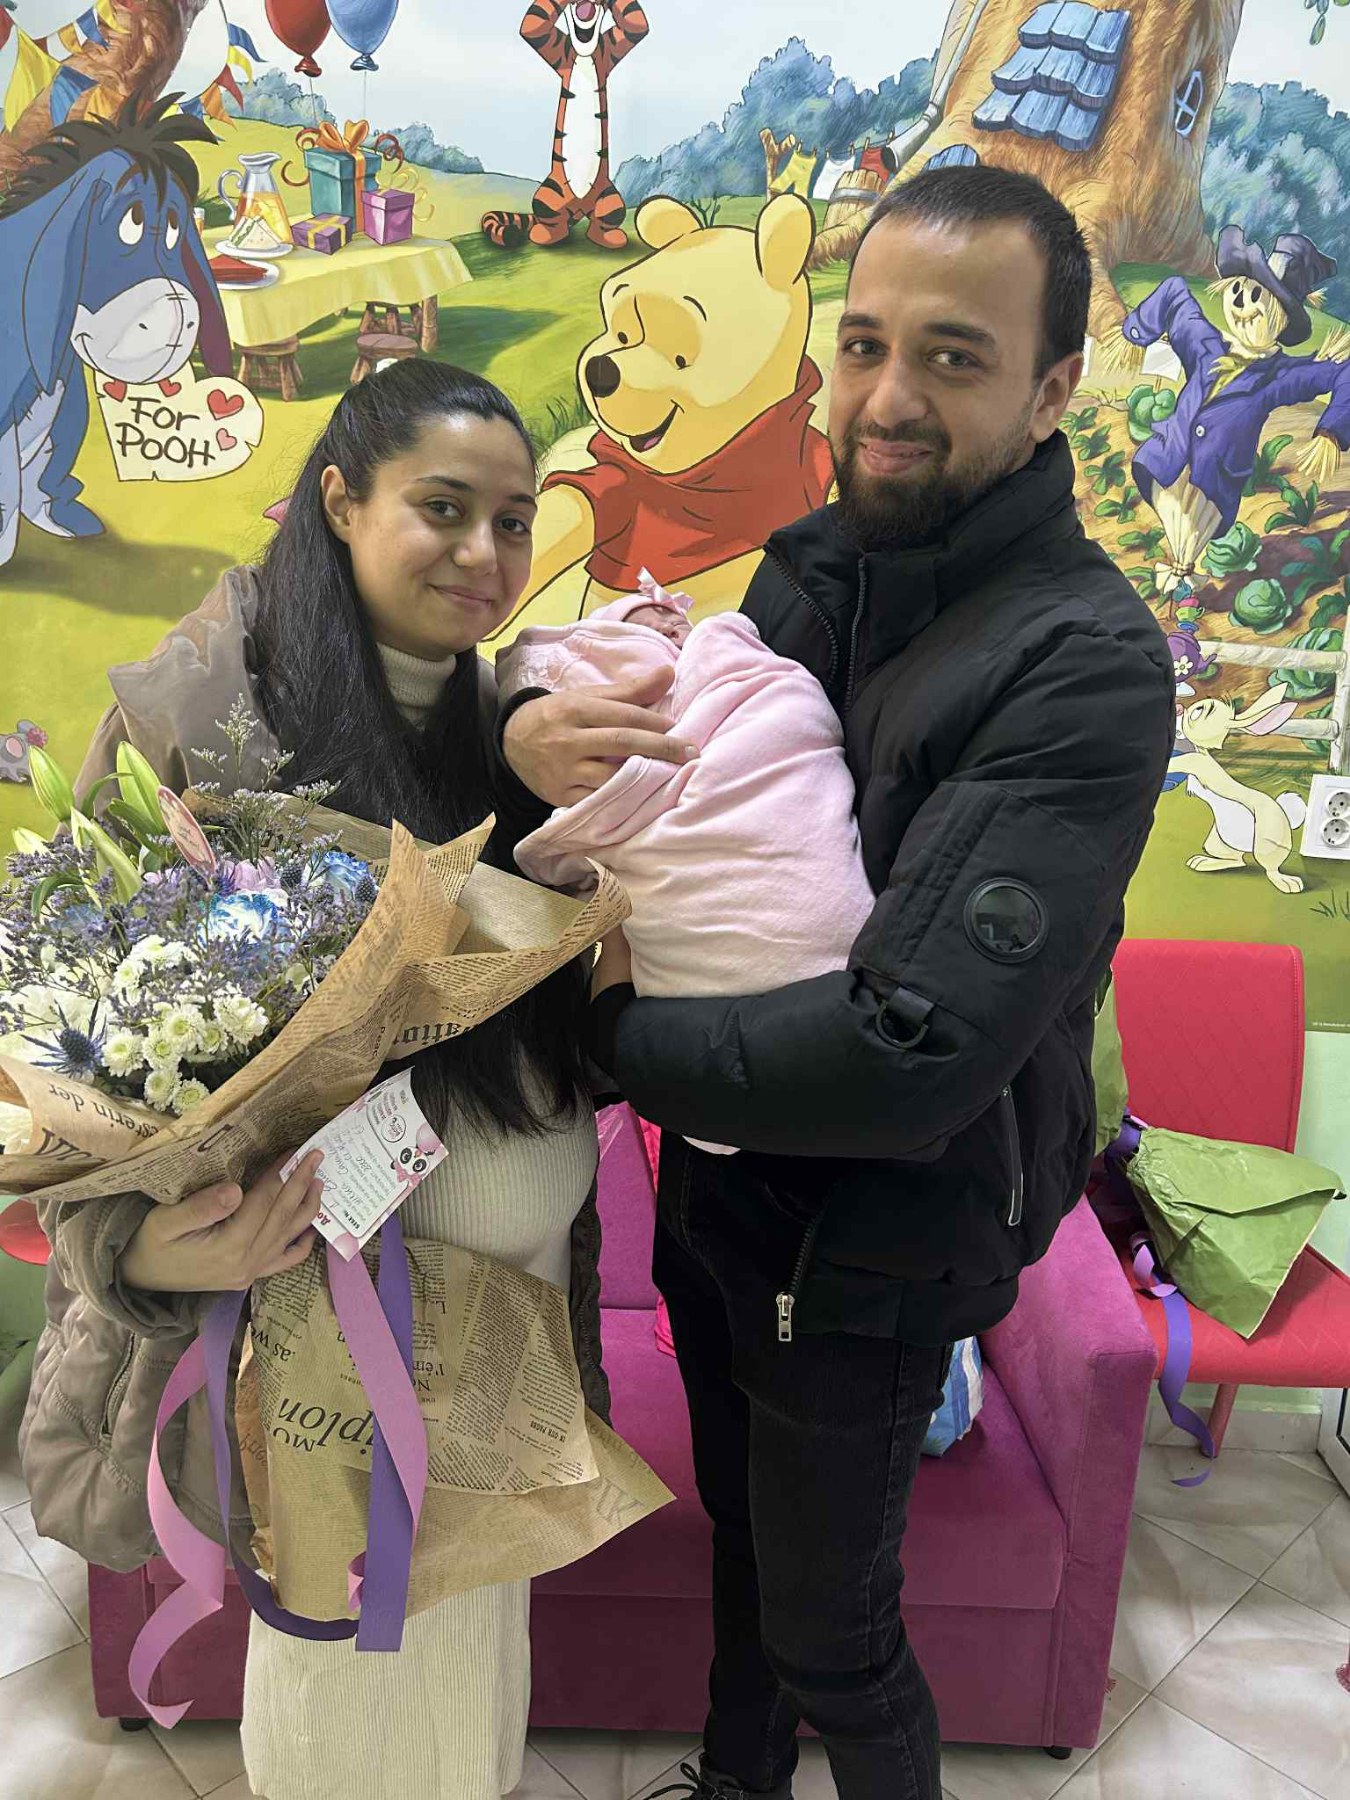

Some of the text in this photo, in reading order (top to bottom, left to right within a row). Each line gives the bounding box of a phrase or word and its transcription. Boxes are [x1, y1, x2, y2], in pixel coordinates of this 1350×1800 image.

[127, 397, 200, 430] For
[114, 422, 216, 468] POOH
[48, 1083, 85, 1112] der
